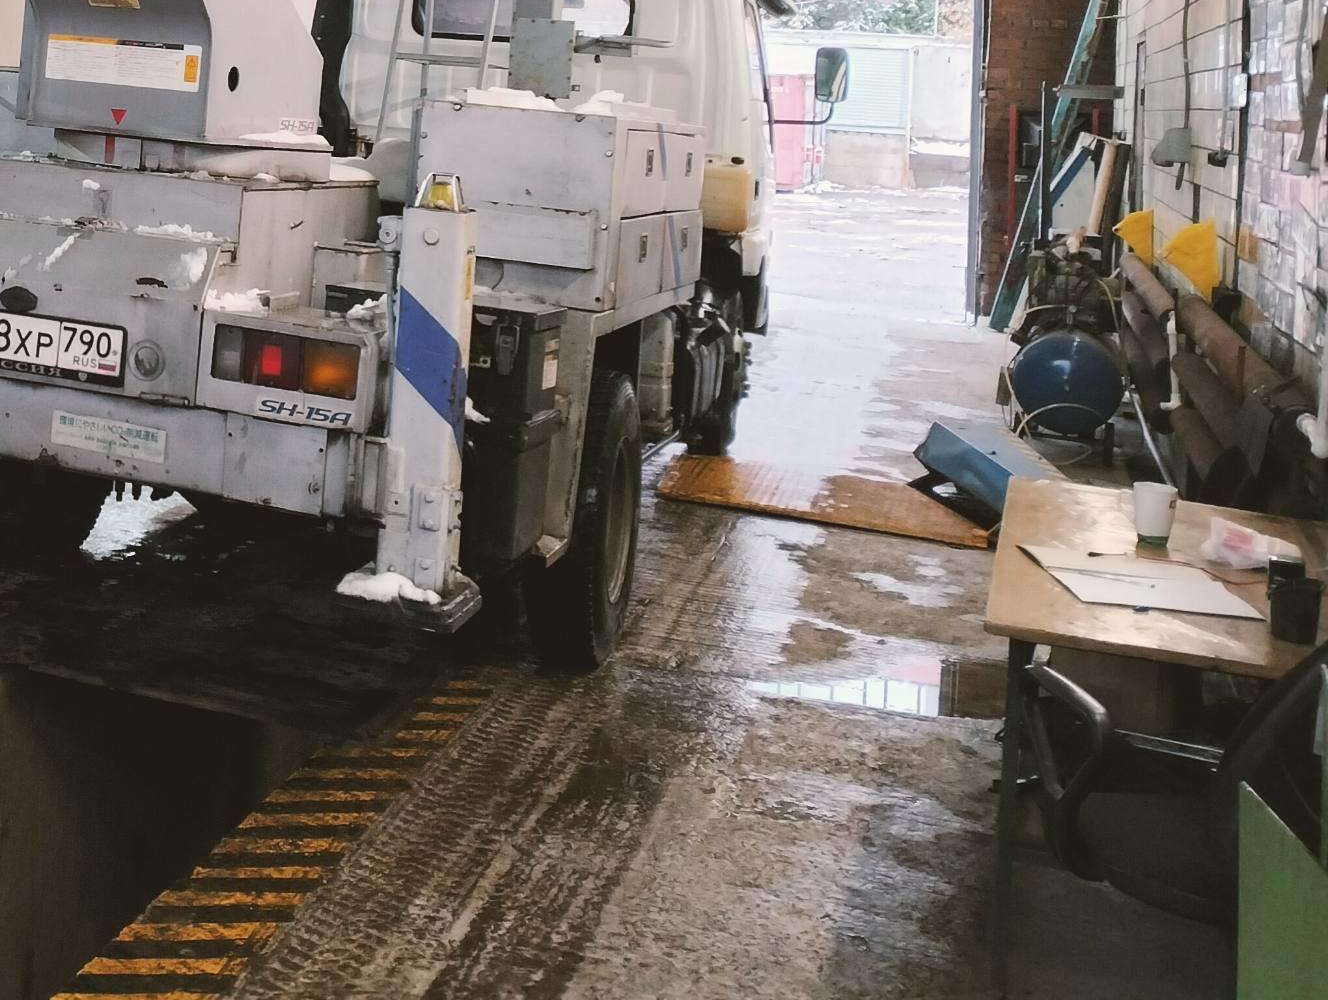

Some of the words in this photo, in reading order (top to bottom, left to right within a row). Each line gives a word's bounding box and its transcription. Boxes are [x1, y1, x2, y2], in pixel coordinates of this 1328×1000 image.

[63, 326, 112, 358] 790
[72, 355, 97, 369] RUS
[258, 399, 353, 426] SH-15A
